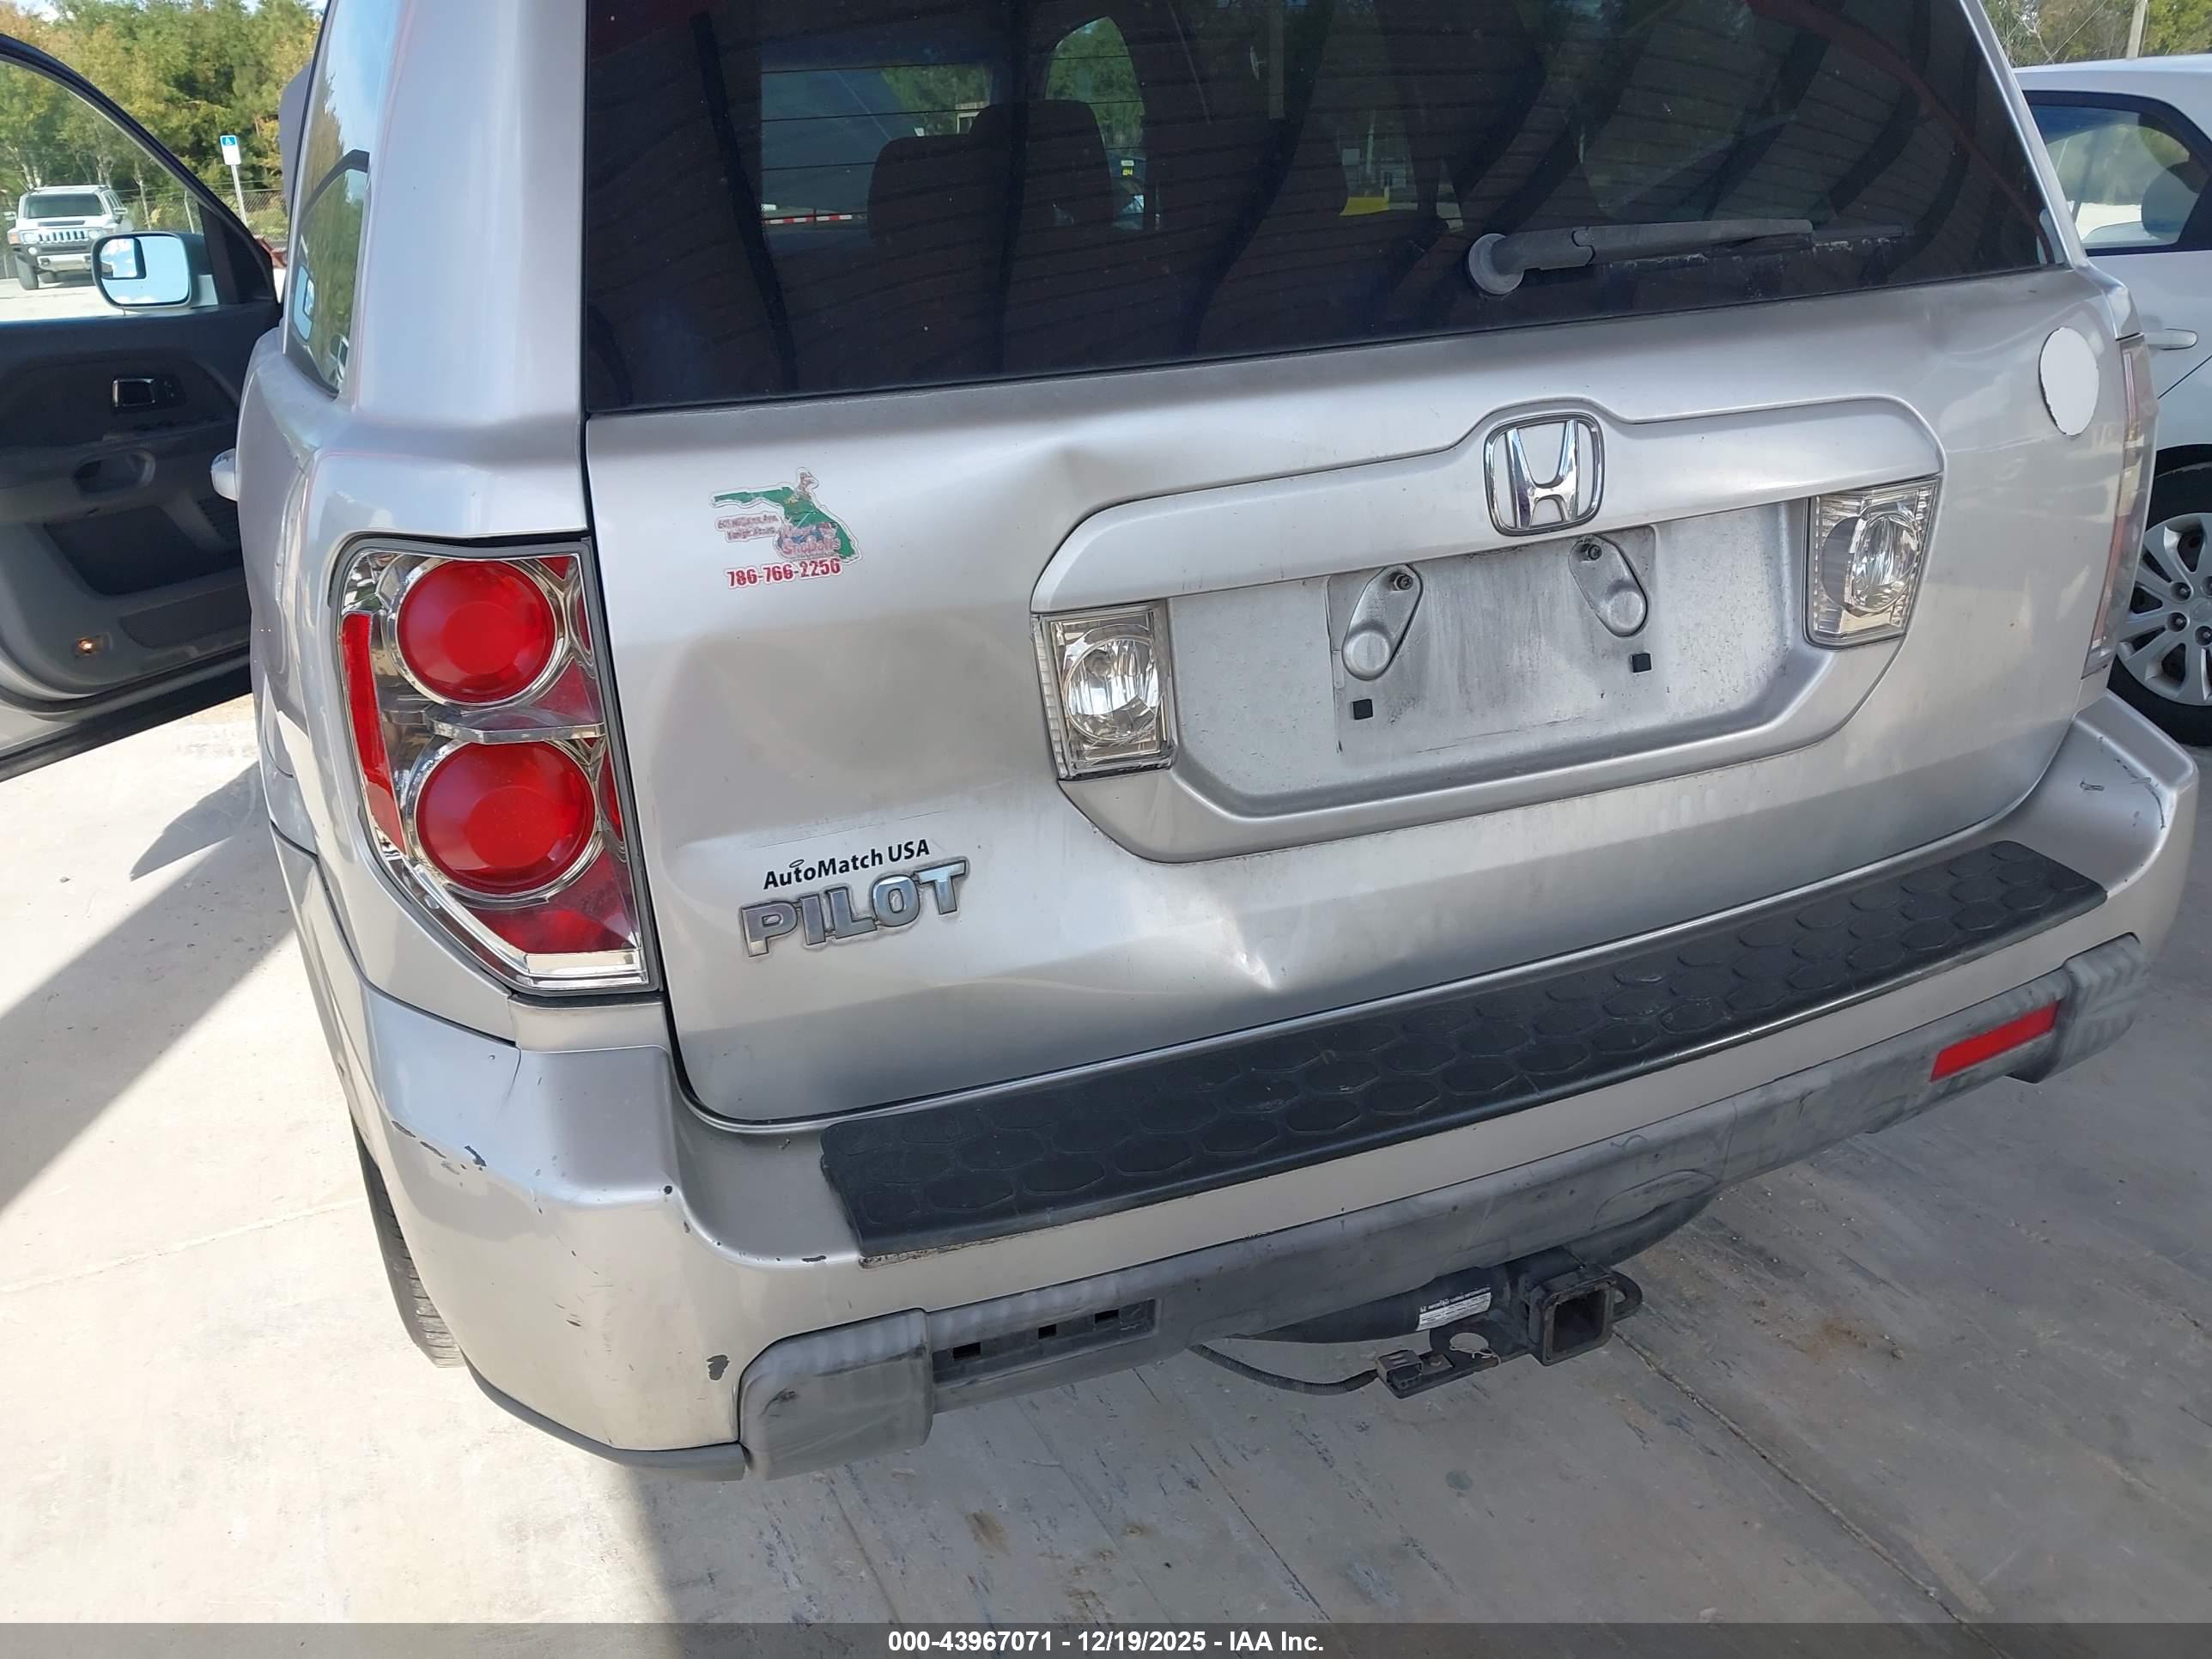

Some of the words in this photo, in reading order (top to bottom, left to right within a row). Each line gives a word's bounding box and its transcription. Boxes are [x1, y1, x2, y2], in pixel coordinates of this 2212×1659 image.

[726, 558, 842, 587] 786-766-2256
[763, 848, 883, 890] AutoMatch
[888, 838, 931, 862] USA
[740, 859, 968, 958] PILOT
